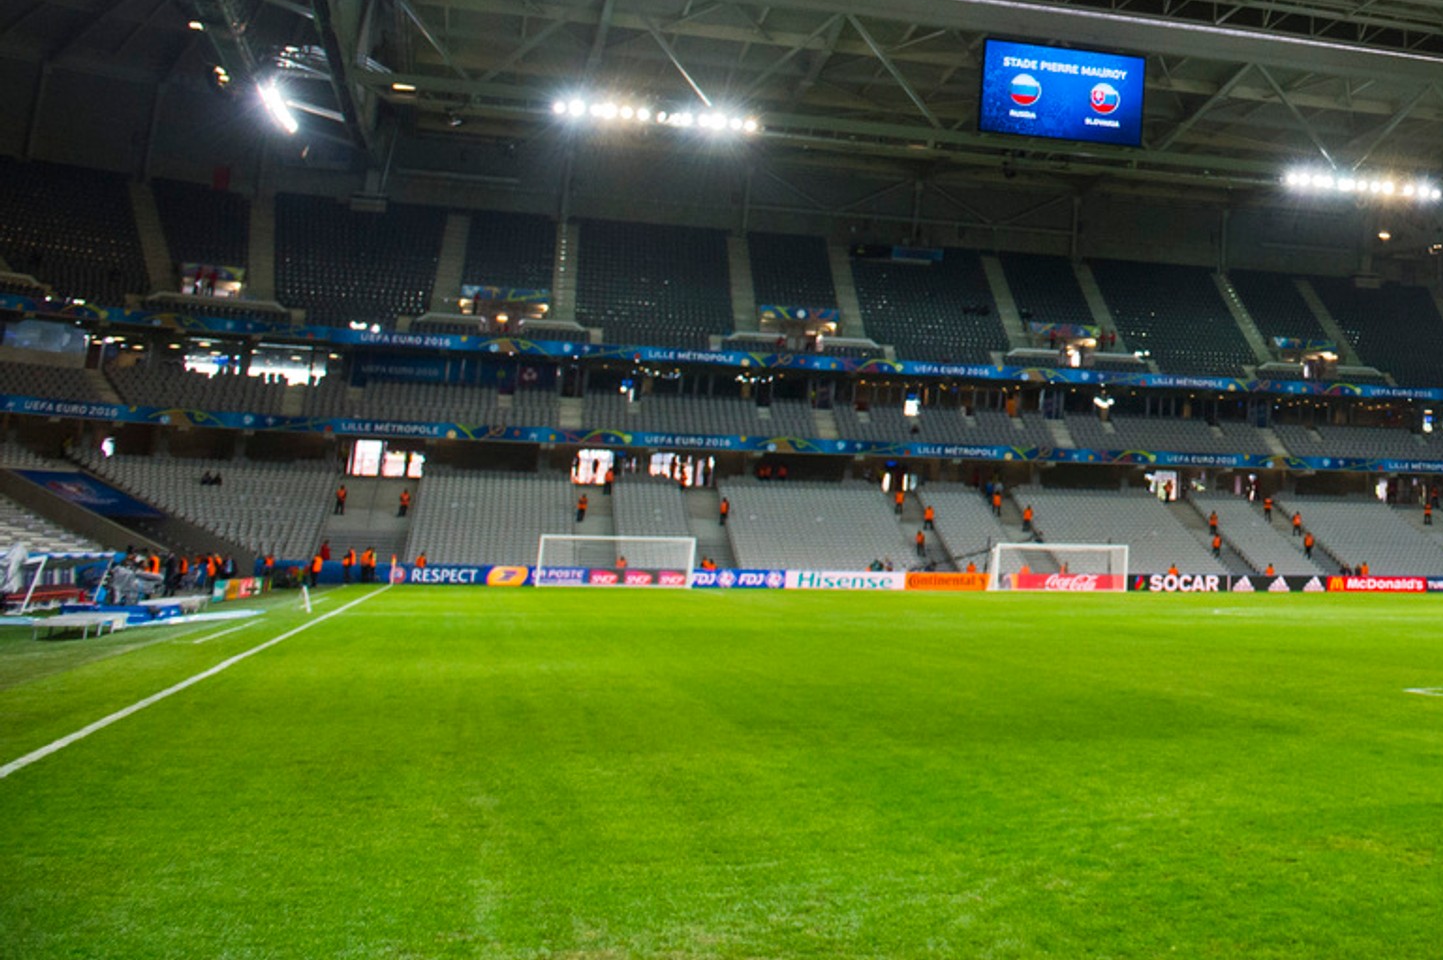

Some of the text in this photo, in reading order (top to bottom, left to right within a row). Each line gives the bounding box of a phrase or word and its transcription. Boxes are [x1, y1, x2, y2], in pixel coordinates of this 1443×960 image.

[1003, 56, 1128, 81] STADE PIERRE MAUROY
[360, 333, 451, 347] UEFA EURO 2016
[648, 350, 675, 359] LILLE
[914, 364, 989, 376] UEFA EURO 2016
[1152, 377, 1174, 386] LILLE
[1370, 388, 1391, 396] UEFA
[1392, 389, 1413, 397] EURO
[24, 400, 119, 417] UEFA EURO 2016
[341, 422, 439, 435] LILLE MÉTROPOLE
[644, 435, 731, 447] UEFA EURO 2016
[917, 446, 942, 454] LILLE
[1166, 455, 1190, 463] UEFA
[1191, 455, 1215, 464] EURO
[1388, 462, 1409, 470] LILLE
[411, 567, 479, 583] RESPECT
[692, 572, 716, 585] FDJ
[738, 572, 764, 585] FDJ
[798, 572, 893, 589] Hisense
[908, 575, 976, 589] Continental
[1149, 574, 1219, 591] SOCAR
[1346, 577, 1424, 590] McDonald's
